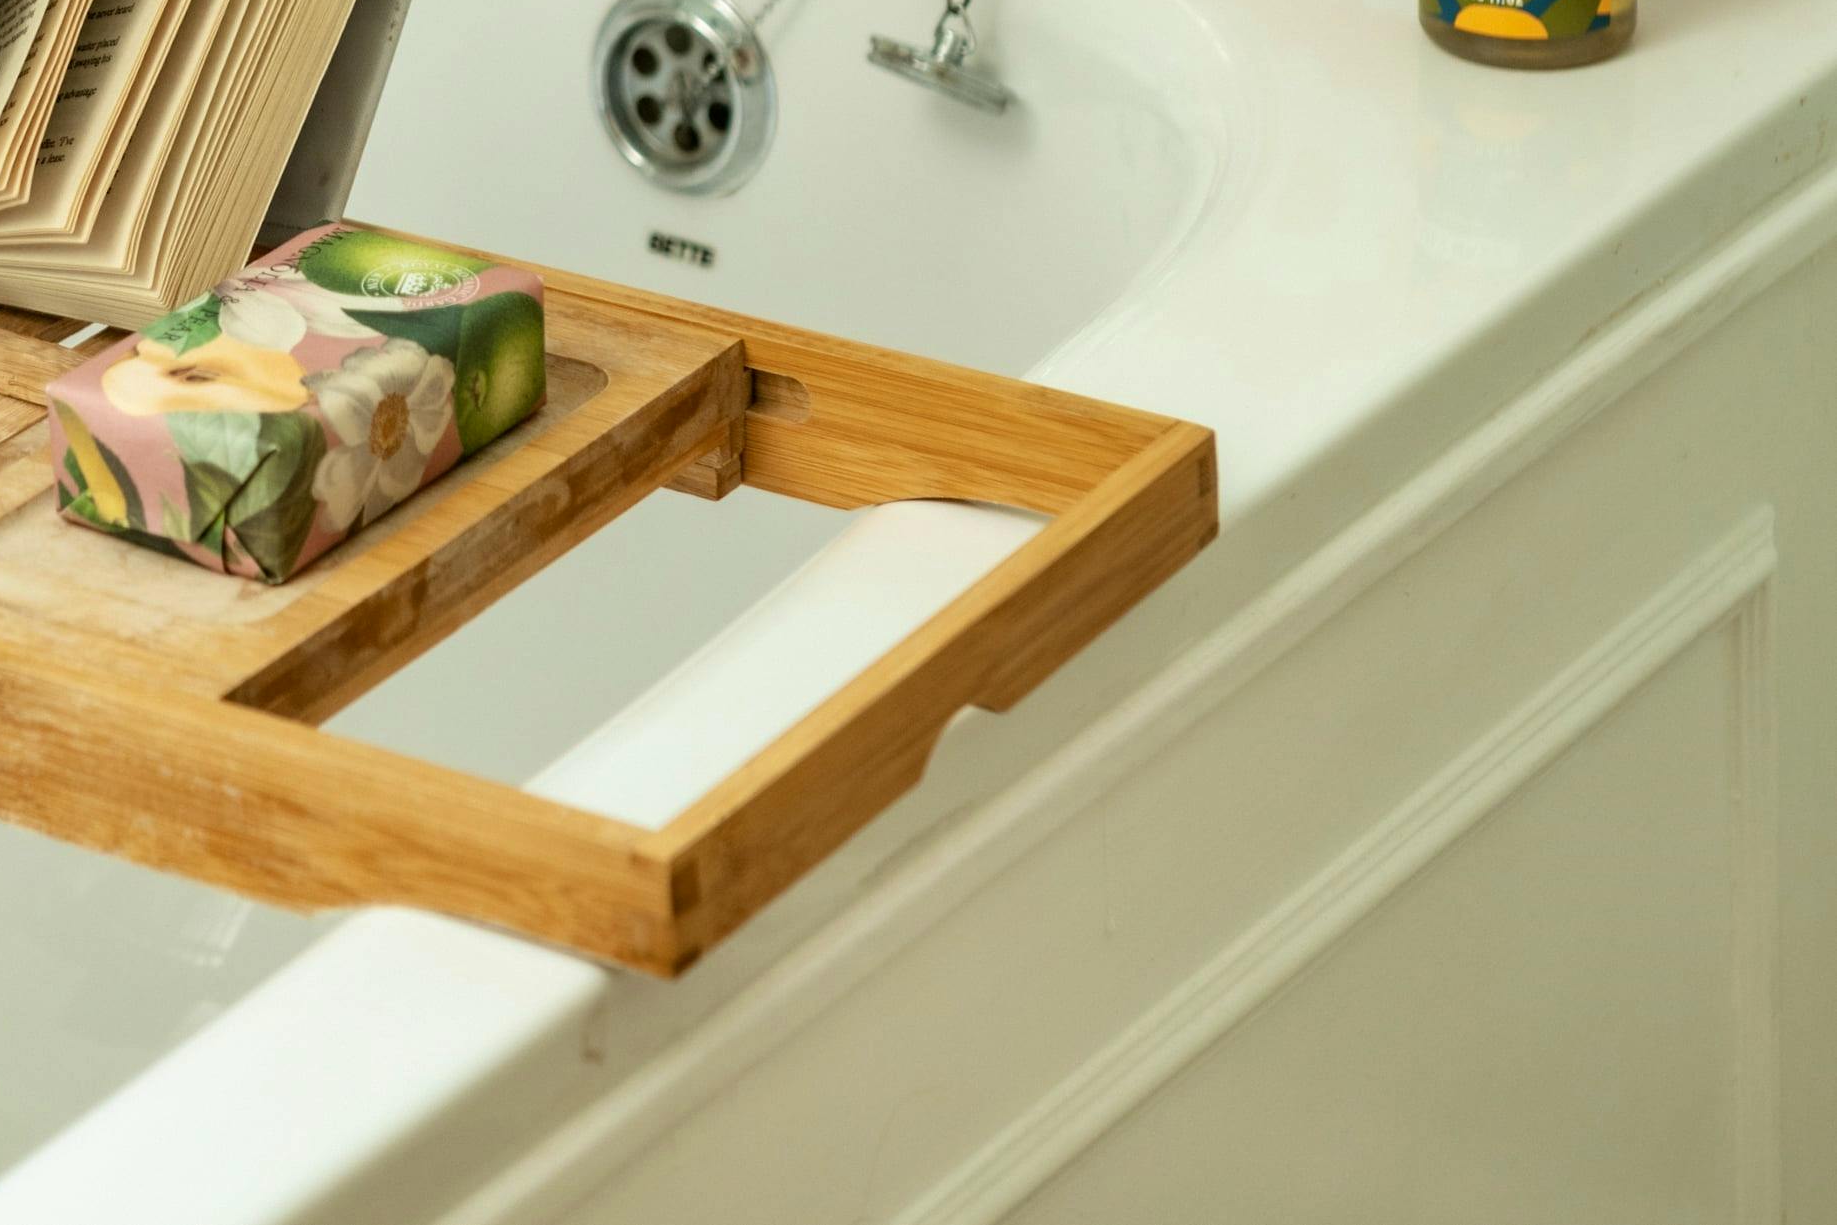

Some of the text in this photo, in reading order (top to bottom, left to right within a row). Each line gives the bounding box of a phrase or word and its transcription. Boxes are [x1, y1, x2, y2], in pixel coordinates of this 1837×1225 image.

[162, 226, 354, 343] MAGNOLIA & PEAR
